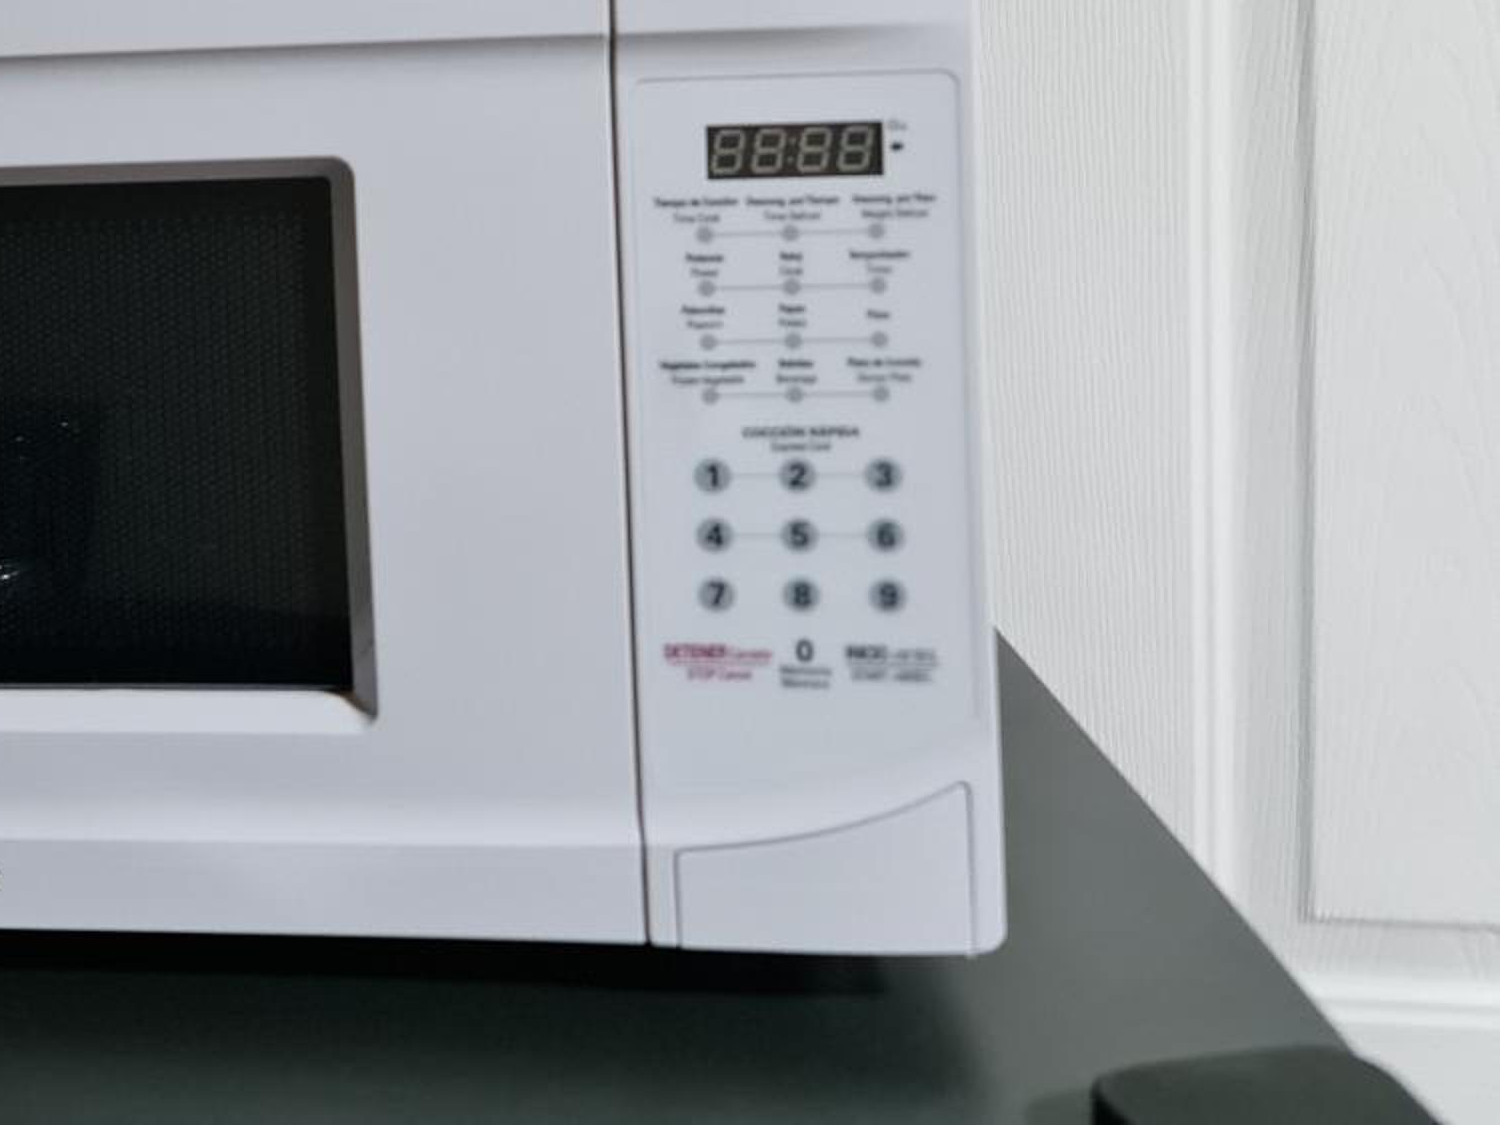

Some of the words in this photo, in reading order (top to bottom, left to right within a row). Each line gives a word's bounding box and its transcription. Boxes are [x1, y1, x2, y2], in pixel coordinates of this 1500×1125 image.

[706, 462, 719, 488] 1
[789, 462, 807, 491] 2
[874, 460, 893, 490] 3
[705, 523, 723, 549] 4
[790, 522, 808, 548] 5
[876, 521, 896, 550] 6
[707, 579, 726, 607] 7
[792, 580, 811, 608] 8
[878, 580, 898, 610] 9
[795, 638, 815, 663] 0
